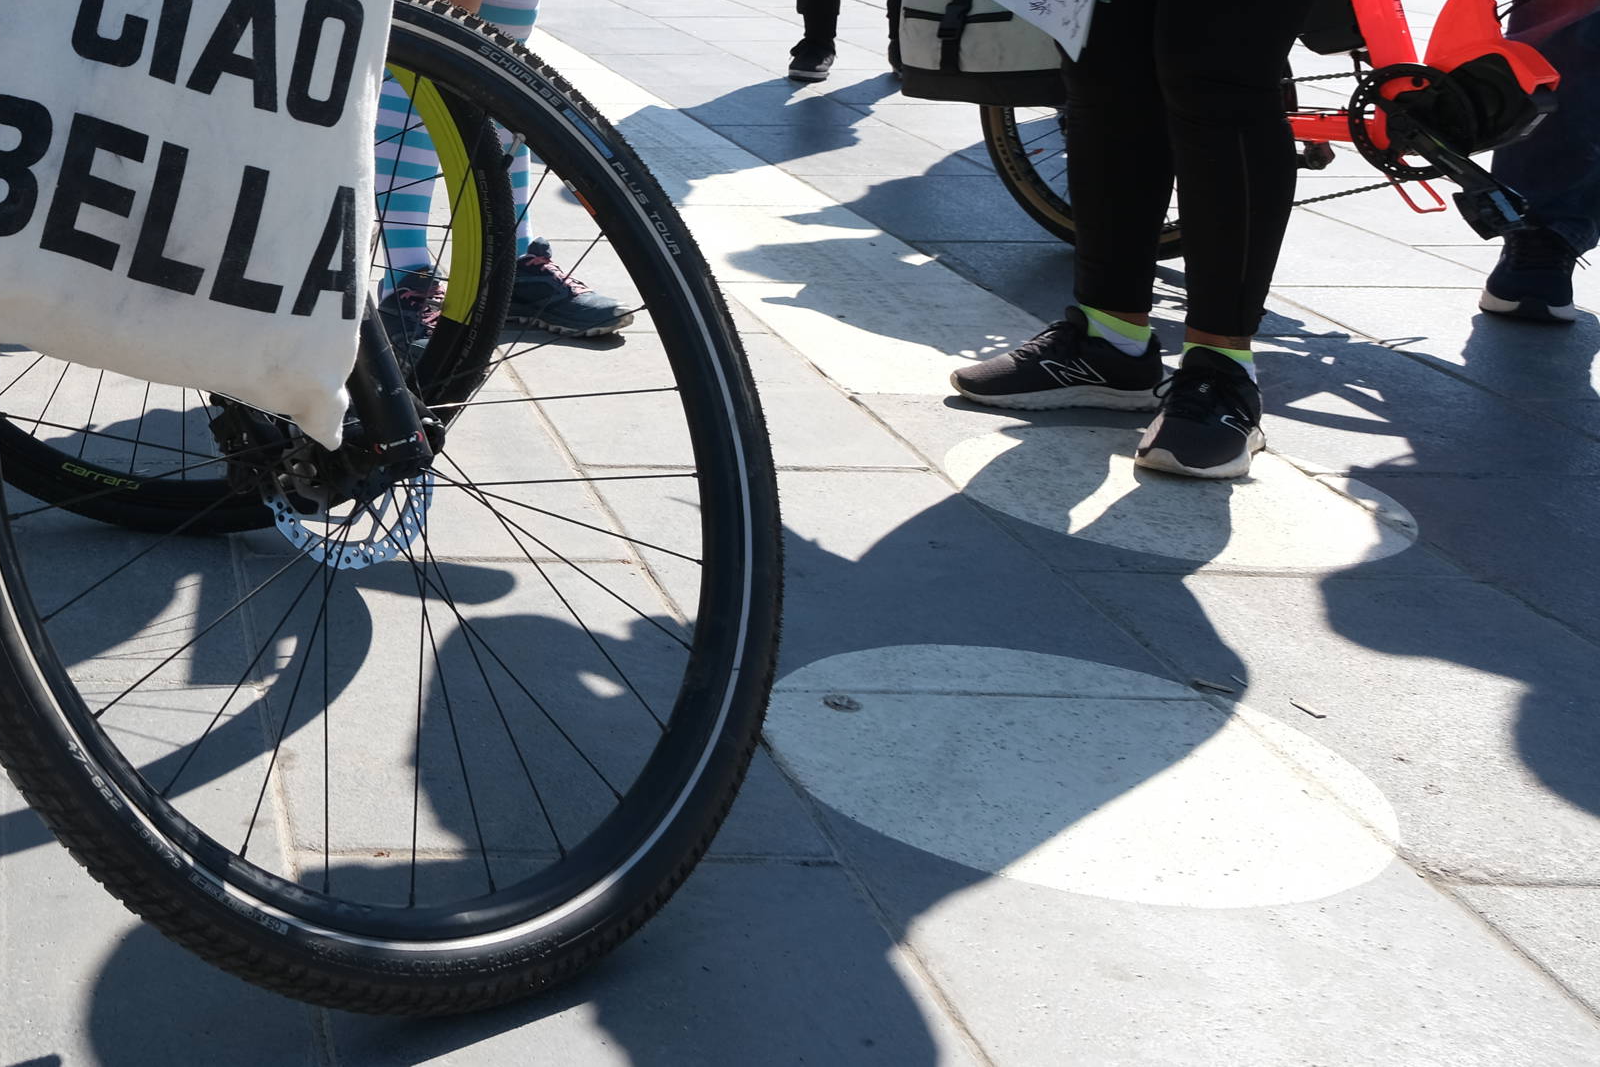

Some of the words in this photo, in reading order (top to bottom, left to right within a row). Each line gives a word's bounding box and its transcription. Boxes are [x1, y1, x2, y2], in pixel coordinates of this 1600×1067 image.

[477, 44, 565, 108] SCHWALBE
[610, 161, 651, 207] PLUS
[649, 211, 683, 257] TOUR
